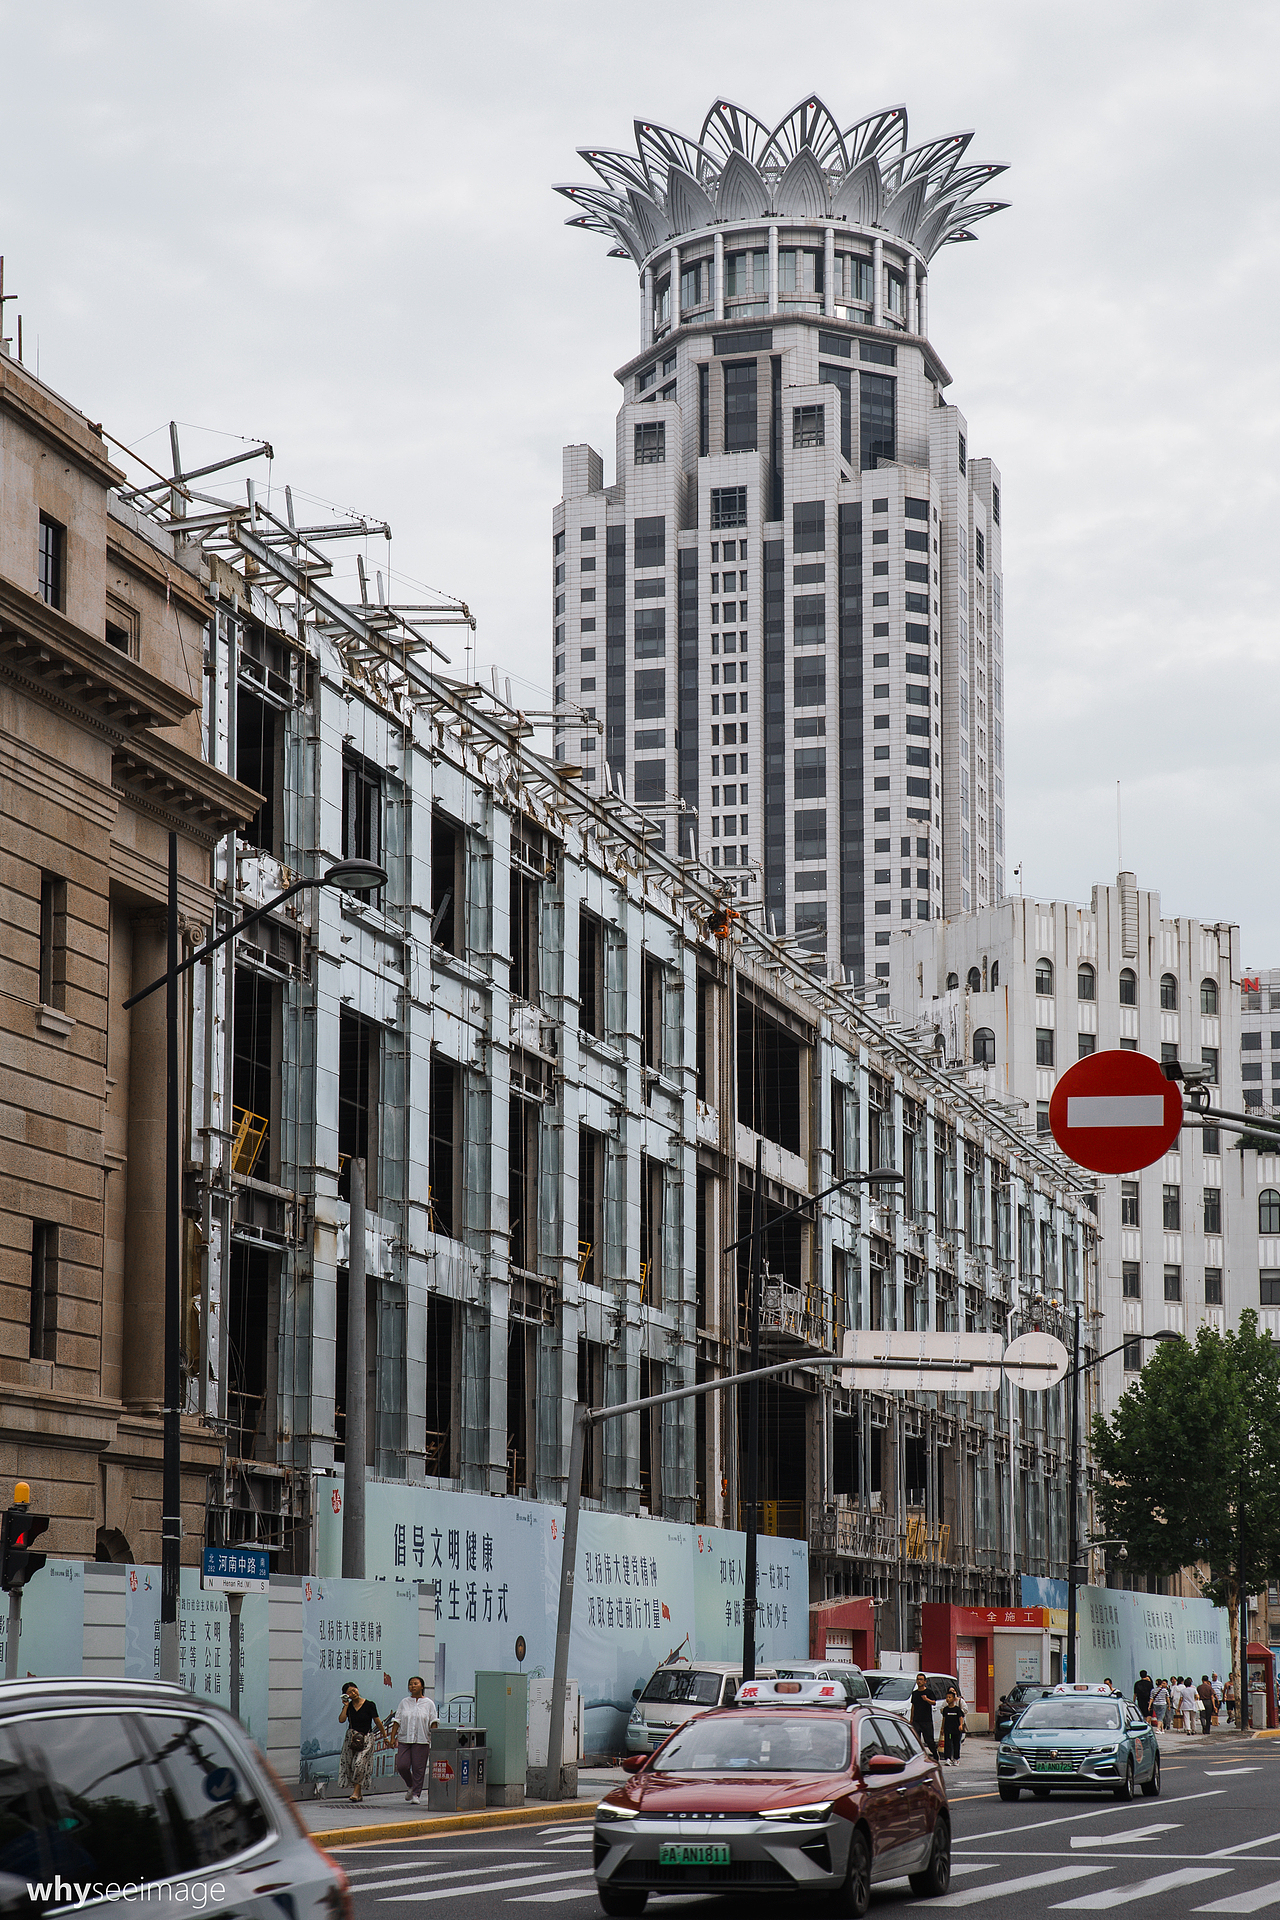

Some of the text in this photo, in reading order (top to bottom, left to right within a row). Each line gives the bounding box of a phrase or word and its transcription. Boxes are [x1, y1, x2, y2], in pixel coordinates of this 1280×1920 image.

[393, 1523, 494, 1572] 倡导文明健康
[218, 1554, 256, 1575] 河南中路
[584, 1551, 658, 1587] 弘扬伟大建党精神
[720, 1557, 791, 1591] 扣好人第一粒扣子
[208, 1578, 214, 1587] N
[222, 1579, 236, 1588] Henan
[260, 1581, 265, 1591] S
[375, 1574, 509, 1623] 保生活方式
[587, 1596, 661, 1629] 汲取奋进前行力量
[725, 1599, 788, 1630] 争做代好少年
[180, 1620, 197, 1642] 民主
[204, 1621, 221, 1642] 文明
[319, 1619, 382, 1642] 弘扬伟大建党精神
[179, 1646, 197, 1668] 平等
[204, 1647, 221, 1668] 公正
[319, 1649, 382, 1671] 汲取奋进前行力量
[204, 1673, 221, 1694] 诚信
